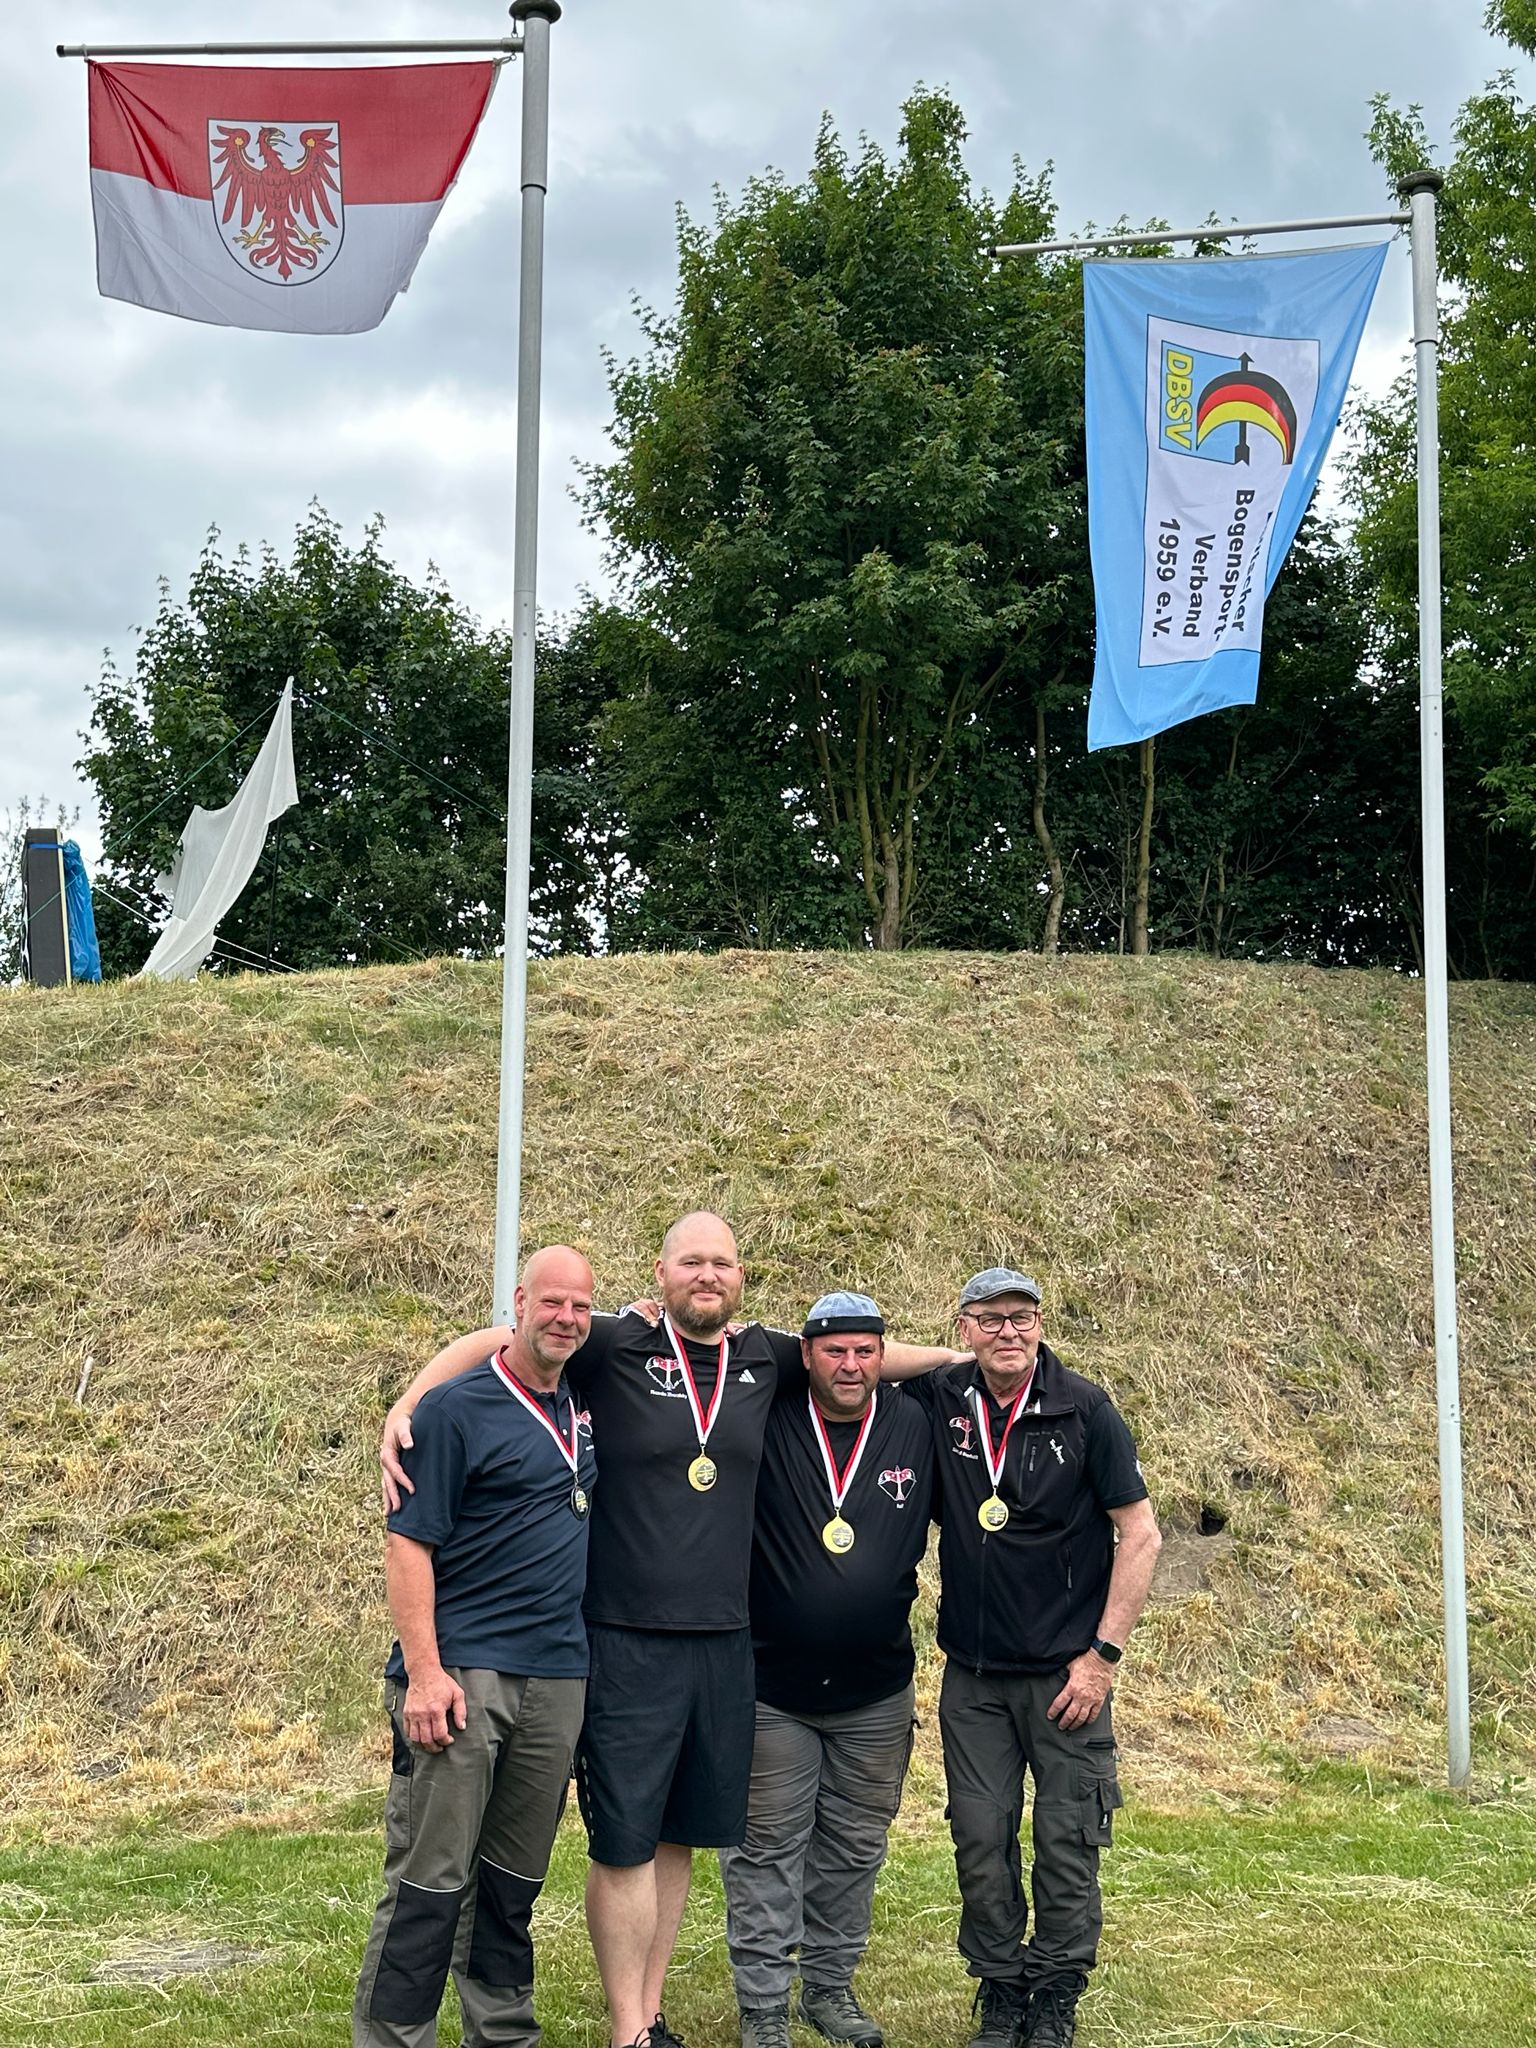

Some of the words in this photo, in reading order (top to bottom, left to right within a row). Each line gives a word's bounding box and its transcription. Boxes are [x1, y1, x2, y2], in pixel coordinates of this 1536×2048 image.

[1165, 349, 1193, 450] DBSV
[1156, 518, 1181, 582] 1959
[1182, 534, 1216, 637] Verband
[1214, 489, 1255, 642] Bogensport-
[1231, 511, 1273, 632] tscher
[1152, 592, 1172, 638] e.V.
